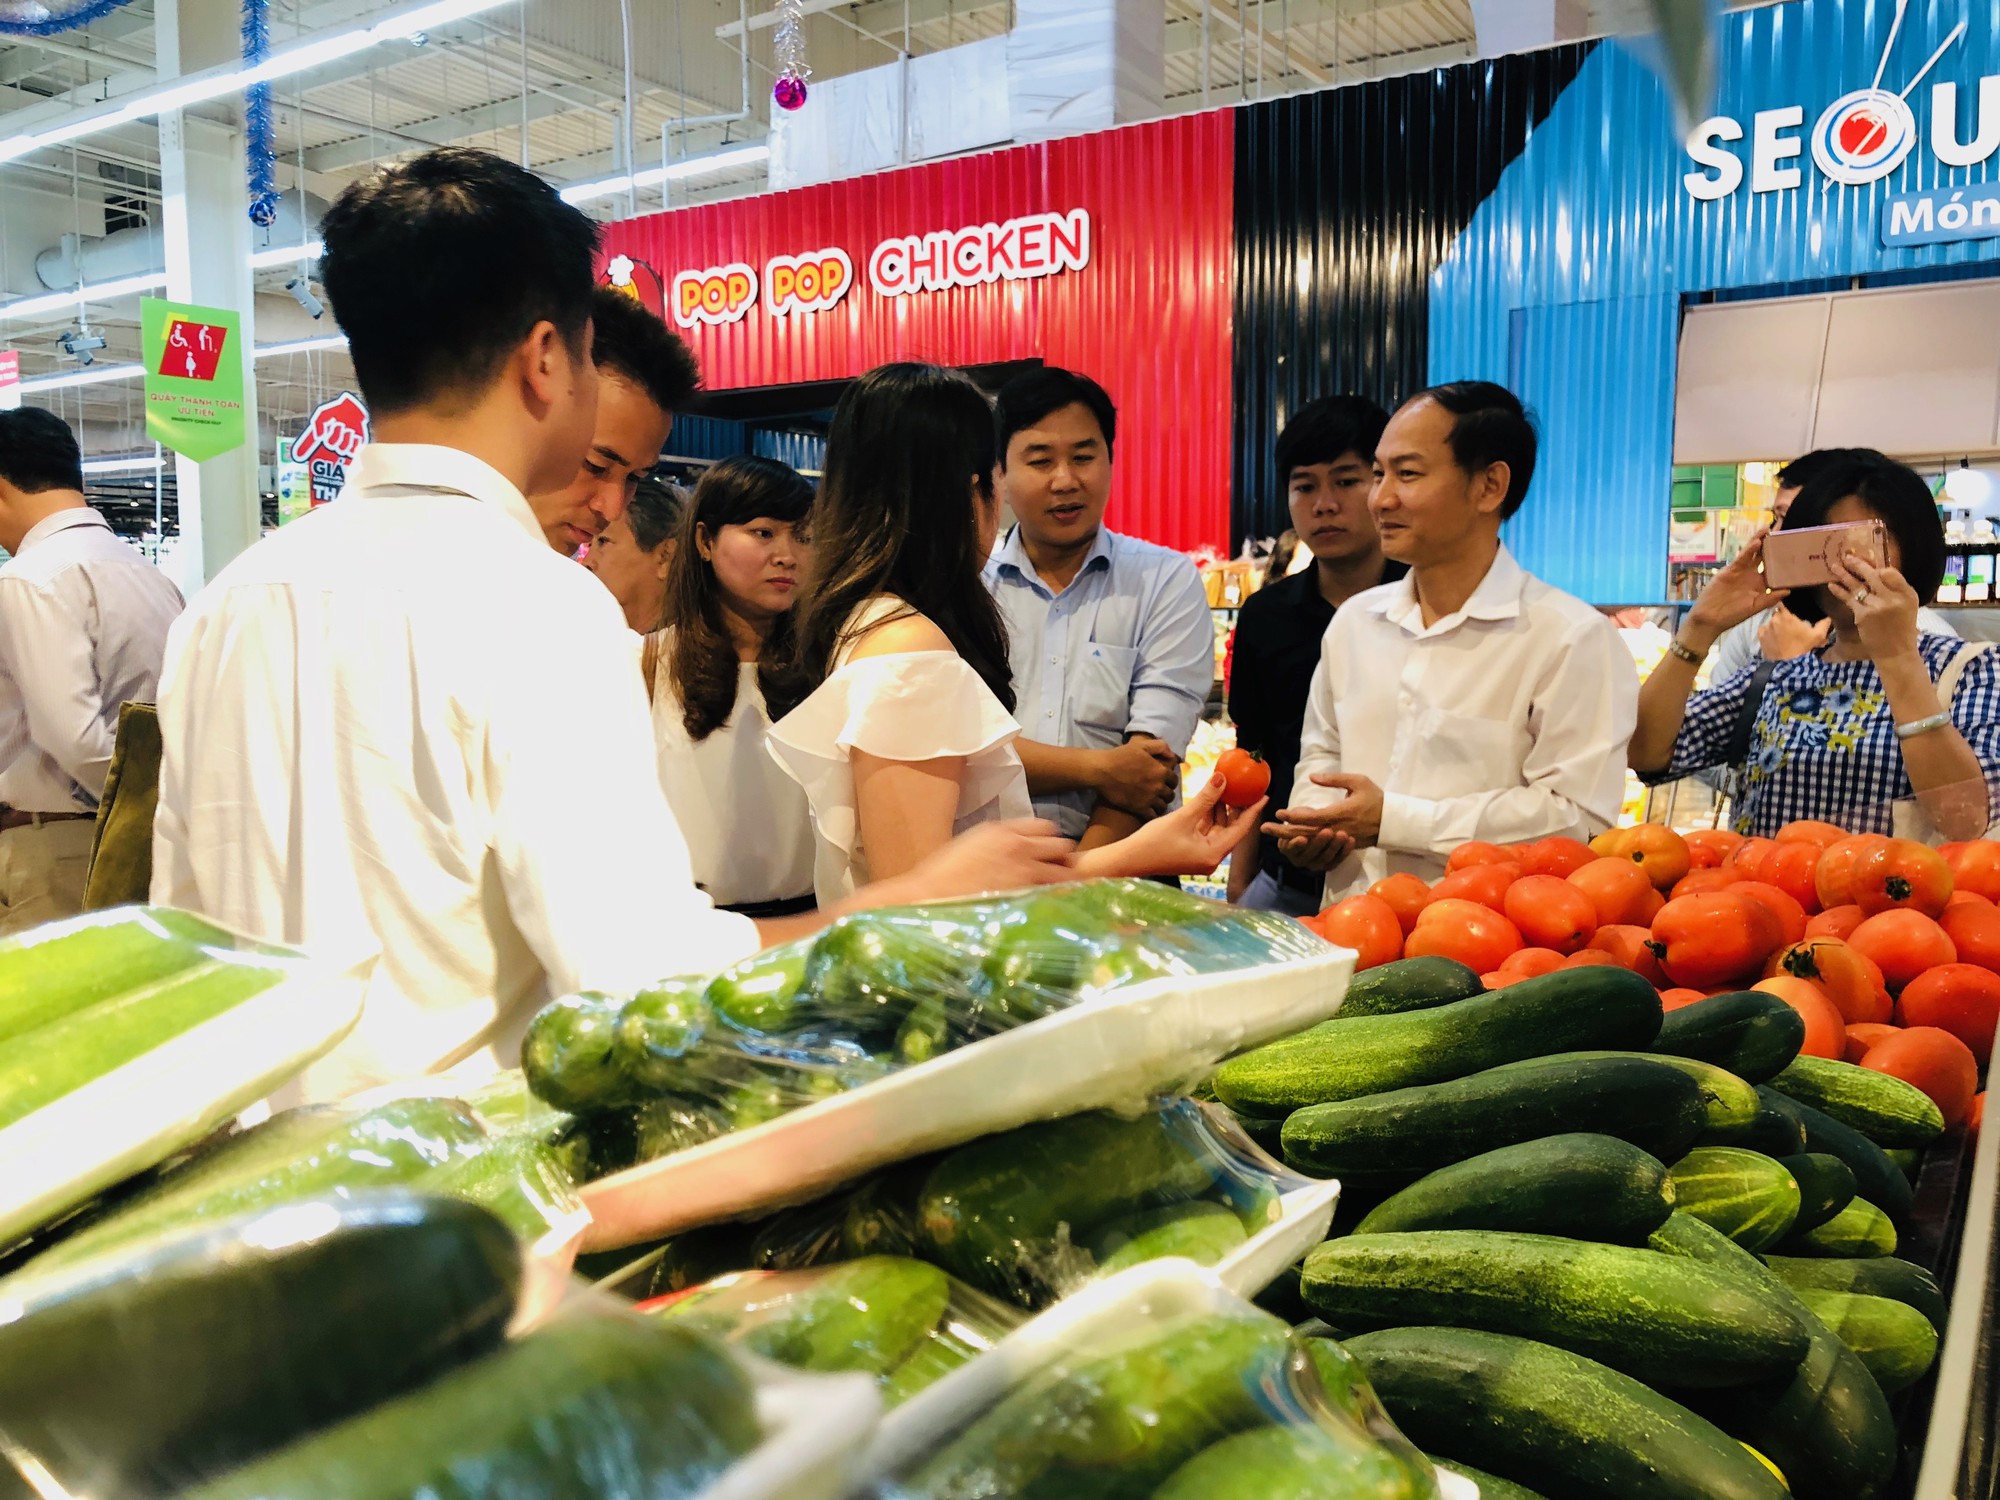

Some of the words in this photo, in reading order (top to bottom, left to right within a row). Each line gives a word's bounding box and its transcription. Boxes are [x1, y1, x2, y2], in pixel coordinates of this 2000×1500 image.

[1684, 75, 2000, 200] SEOU
[1890, 191, 2000, 236] Món
[678, 270, 752, 320] POP
[771, 255, 846, 308] POP
[875, 216, 1083, 288] CHICKEN
[313, 458, 345, 478] GIÁ
